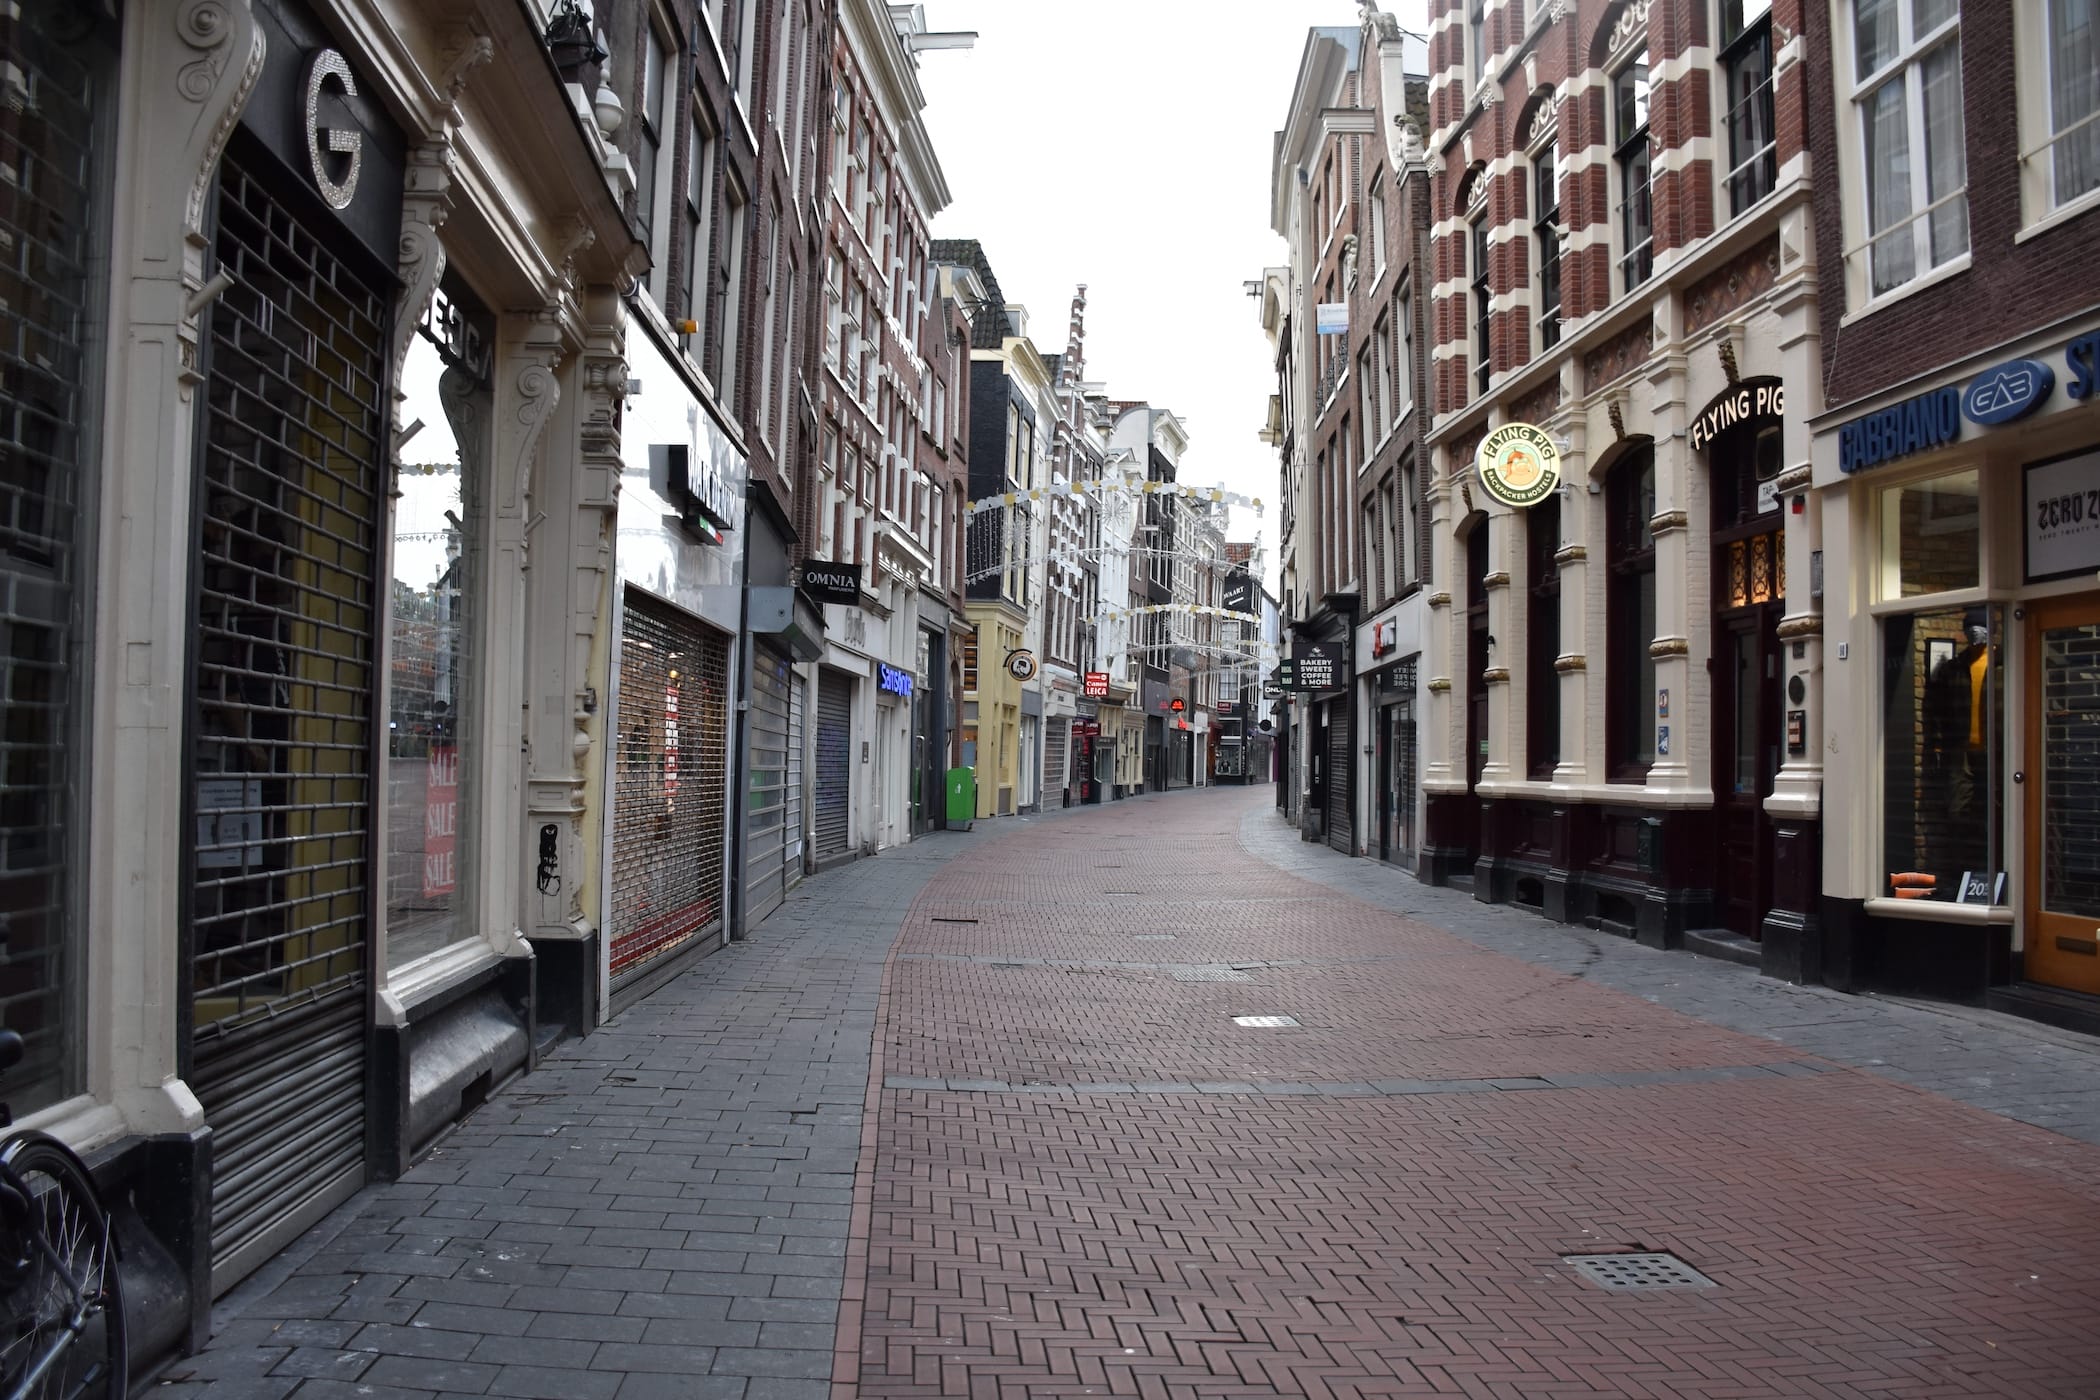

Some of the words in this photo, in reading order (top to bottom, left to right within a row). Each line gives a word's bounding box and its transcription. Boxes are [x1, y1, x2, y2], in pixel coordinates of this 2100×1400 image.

[307, 49, 362, 210] G
[1692, 390, 1749, 451] FLYING
[1757, 386, 1784, 415] PIG
[1839, 386, 1959, 473] GABBIANO
[1485, 427, 1530, 457] FLYING
[1533, 434, 1554, 459] PIG
[1487, 470, 1526, 500] BACKPACKER
[1527, 473, 1552, 498] HOSTELS
[806, 571, 855, 588] OMNIA
[1086, 680, 1107, 688] Canon
[1086, 687, 1107, 695] LEICA
[429, 751, 457, 787] SALE
[428, 801, 457, 839] SALE
[424, 851, 454, 891] SALE
